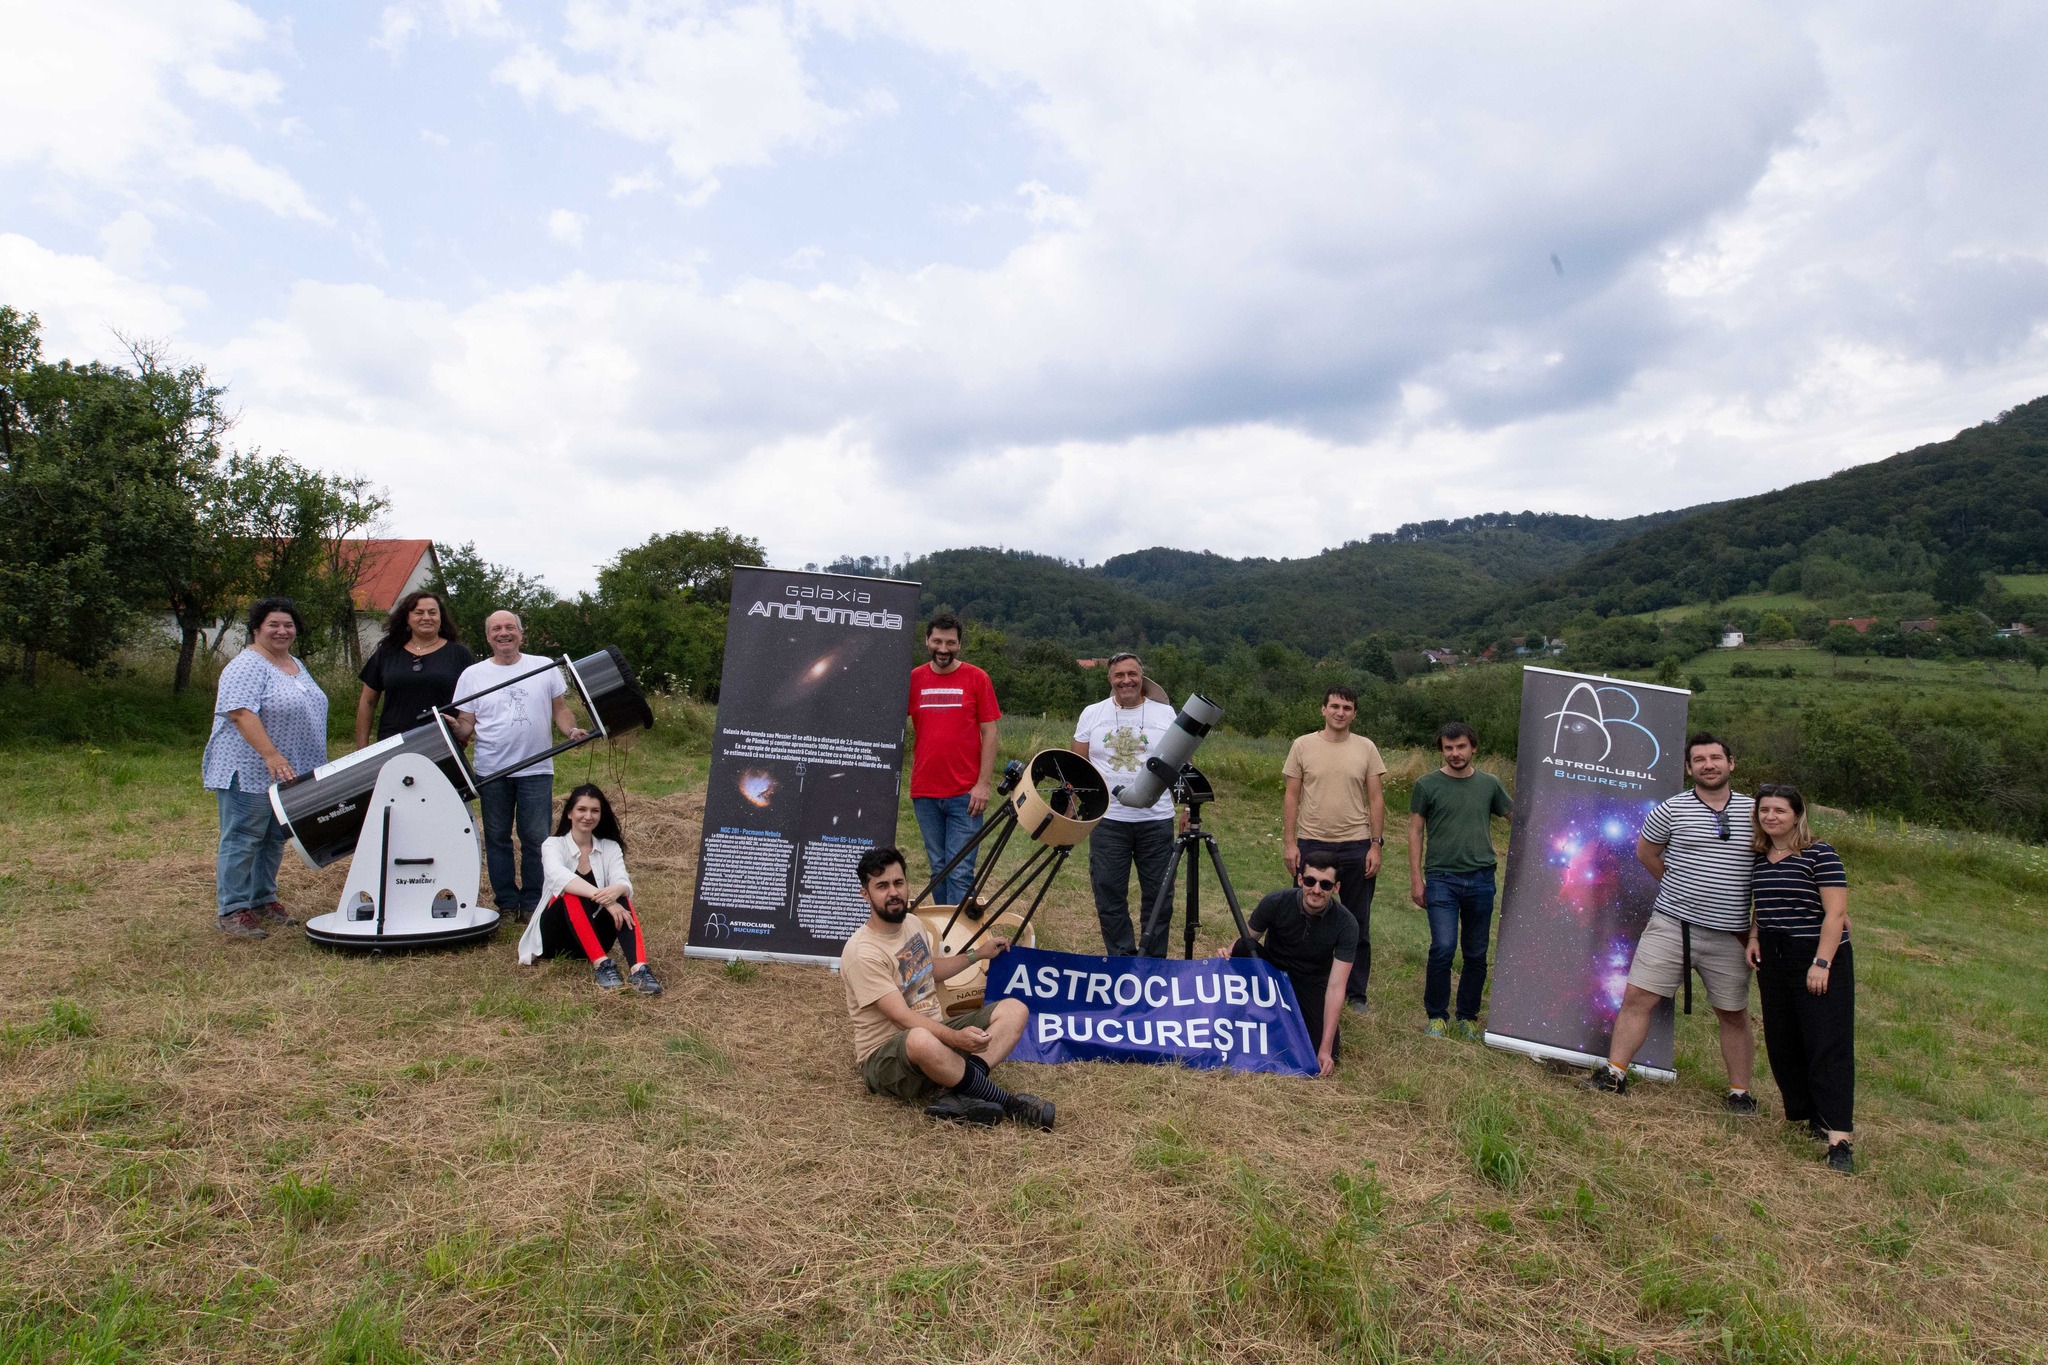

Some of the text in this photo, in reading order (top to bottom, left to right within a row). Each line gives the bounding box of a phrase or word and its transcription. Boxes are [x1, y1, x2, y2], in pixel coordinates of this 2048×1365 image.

[786, 585, 871, 604] Galaxia
[748, 600, 903, 630] Andromeda
[1542, 756, 1656, 781] ASTROCLUBUL
[730, 920, 776, 929] ASTROCLUBUL
[1003, 964, 1291, 1012] ASTROCLUBUL
[1038, 1013, 1267, 1061] BUCUREȘTI
